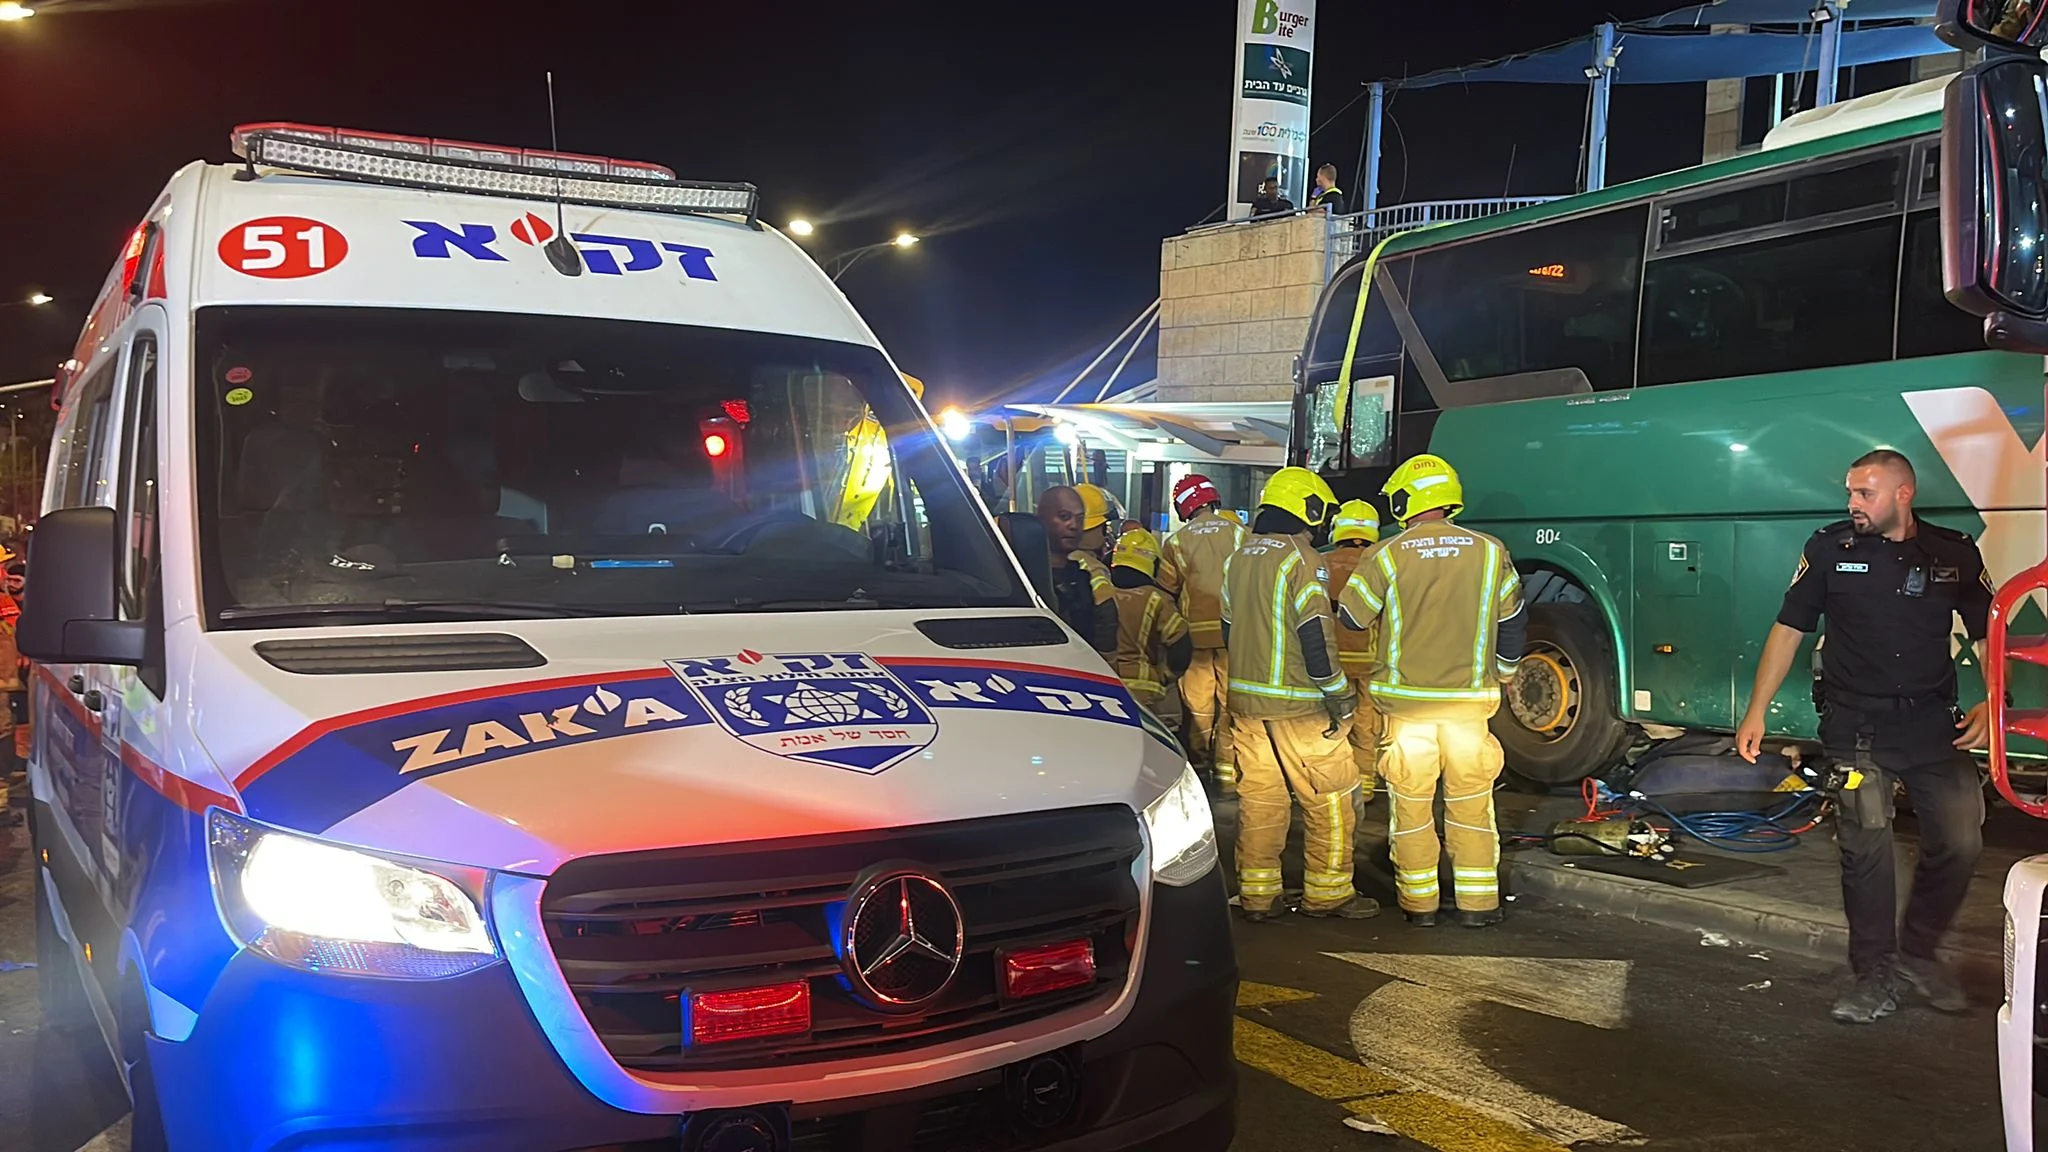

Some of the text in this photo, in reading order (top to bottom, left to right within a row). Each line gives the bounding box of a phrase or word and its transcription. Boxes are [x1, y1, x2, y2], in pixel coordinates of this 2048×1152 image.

[1244, 79, 1270, 90] הבית
[1272, 81, 1285, 92] עד
[241, 225, 326, 270] 51
[1401, 536, 1474, 550] כבאות והצלה
[1417, 547, 1460, 559] לישראל
[690, 676, 756, 686] הצלה
[760, 672, 822, 681] חילוץ
[780, 728, 910, 747] חסד של אמת
